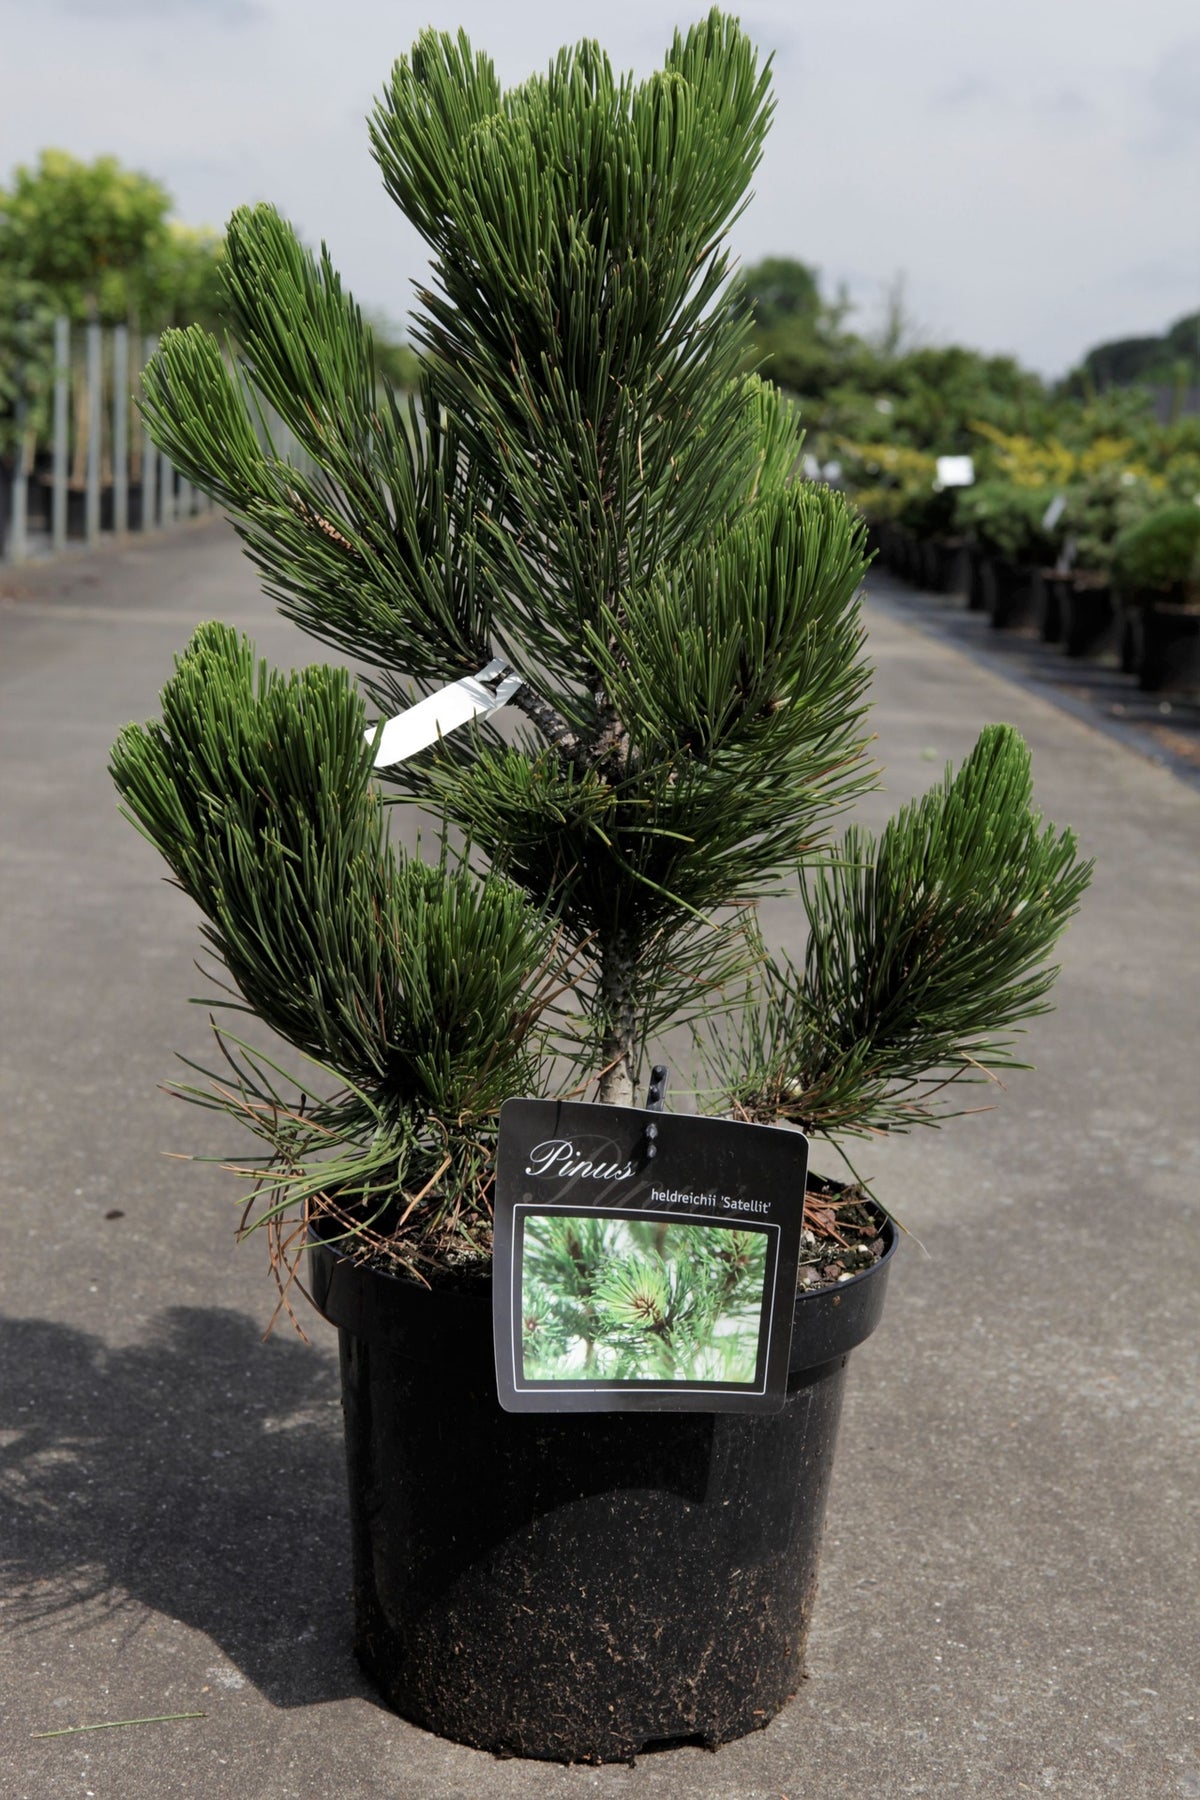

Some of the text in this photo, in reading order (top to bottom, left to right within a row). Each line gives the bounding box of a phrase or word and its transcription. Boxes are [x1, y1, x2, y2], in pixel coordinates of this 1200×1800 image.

[525, 1139, 635, 1181] Pinus
[651, 1188, 771, 1214] heldreichii 'Satellit'
